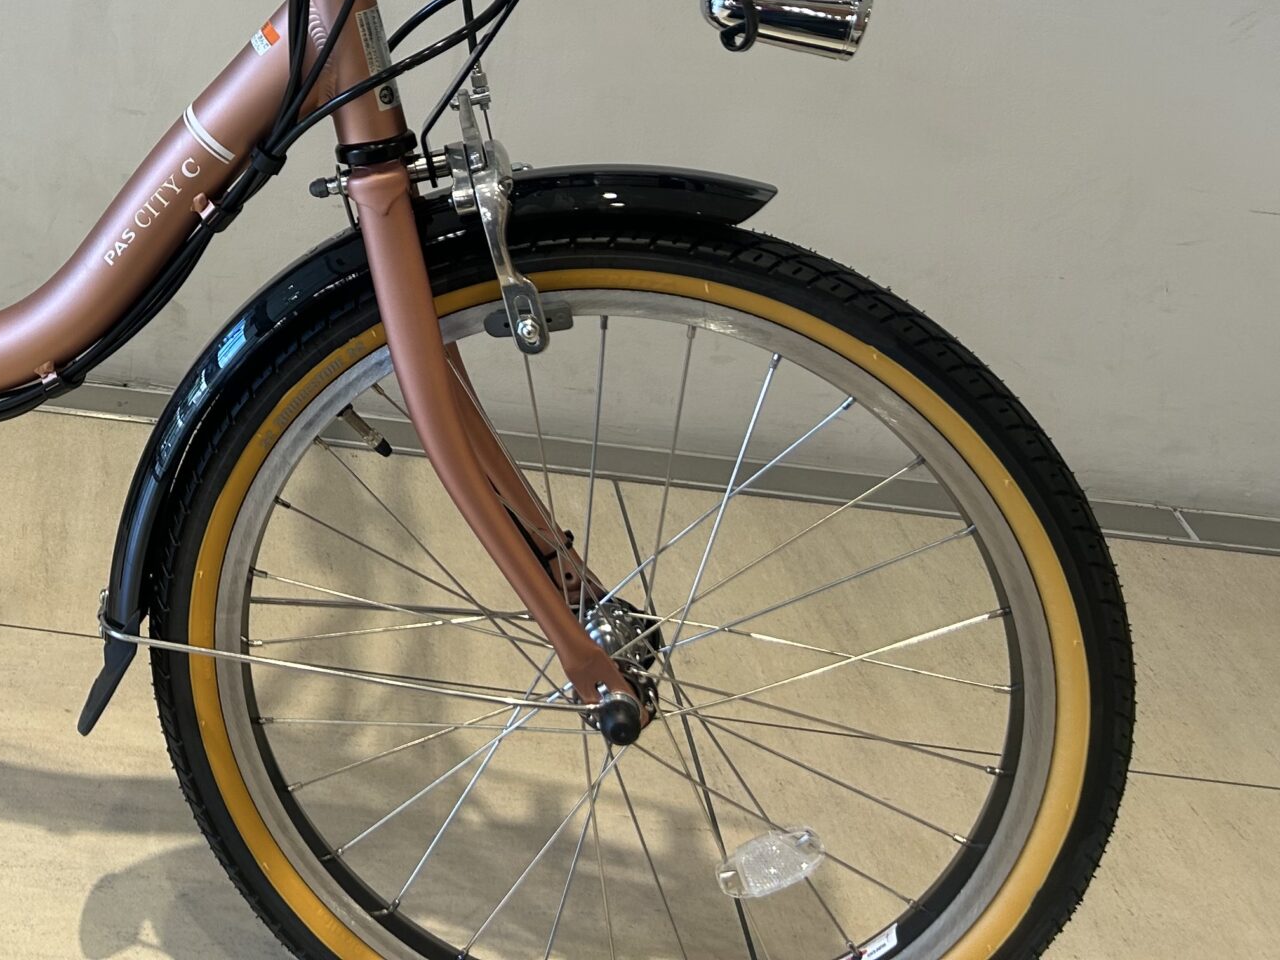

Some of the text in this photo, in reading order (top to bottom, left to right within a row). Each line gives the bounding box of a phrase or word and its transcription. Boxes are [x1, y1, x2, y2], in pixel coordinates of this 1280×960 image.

[103, 157, 201, 266] PAS CITY C
